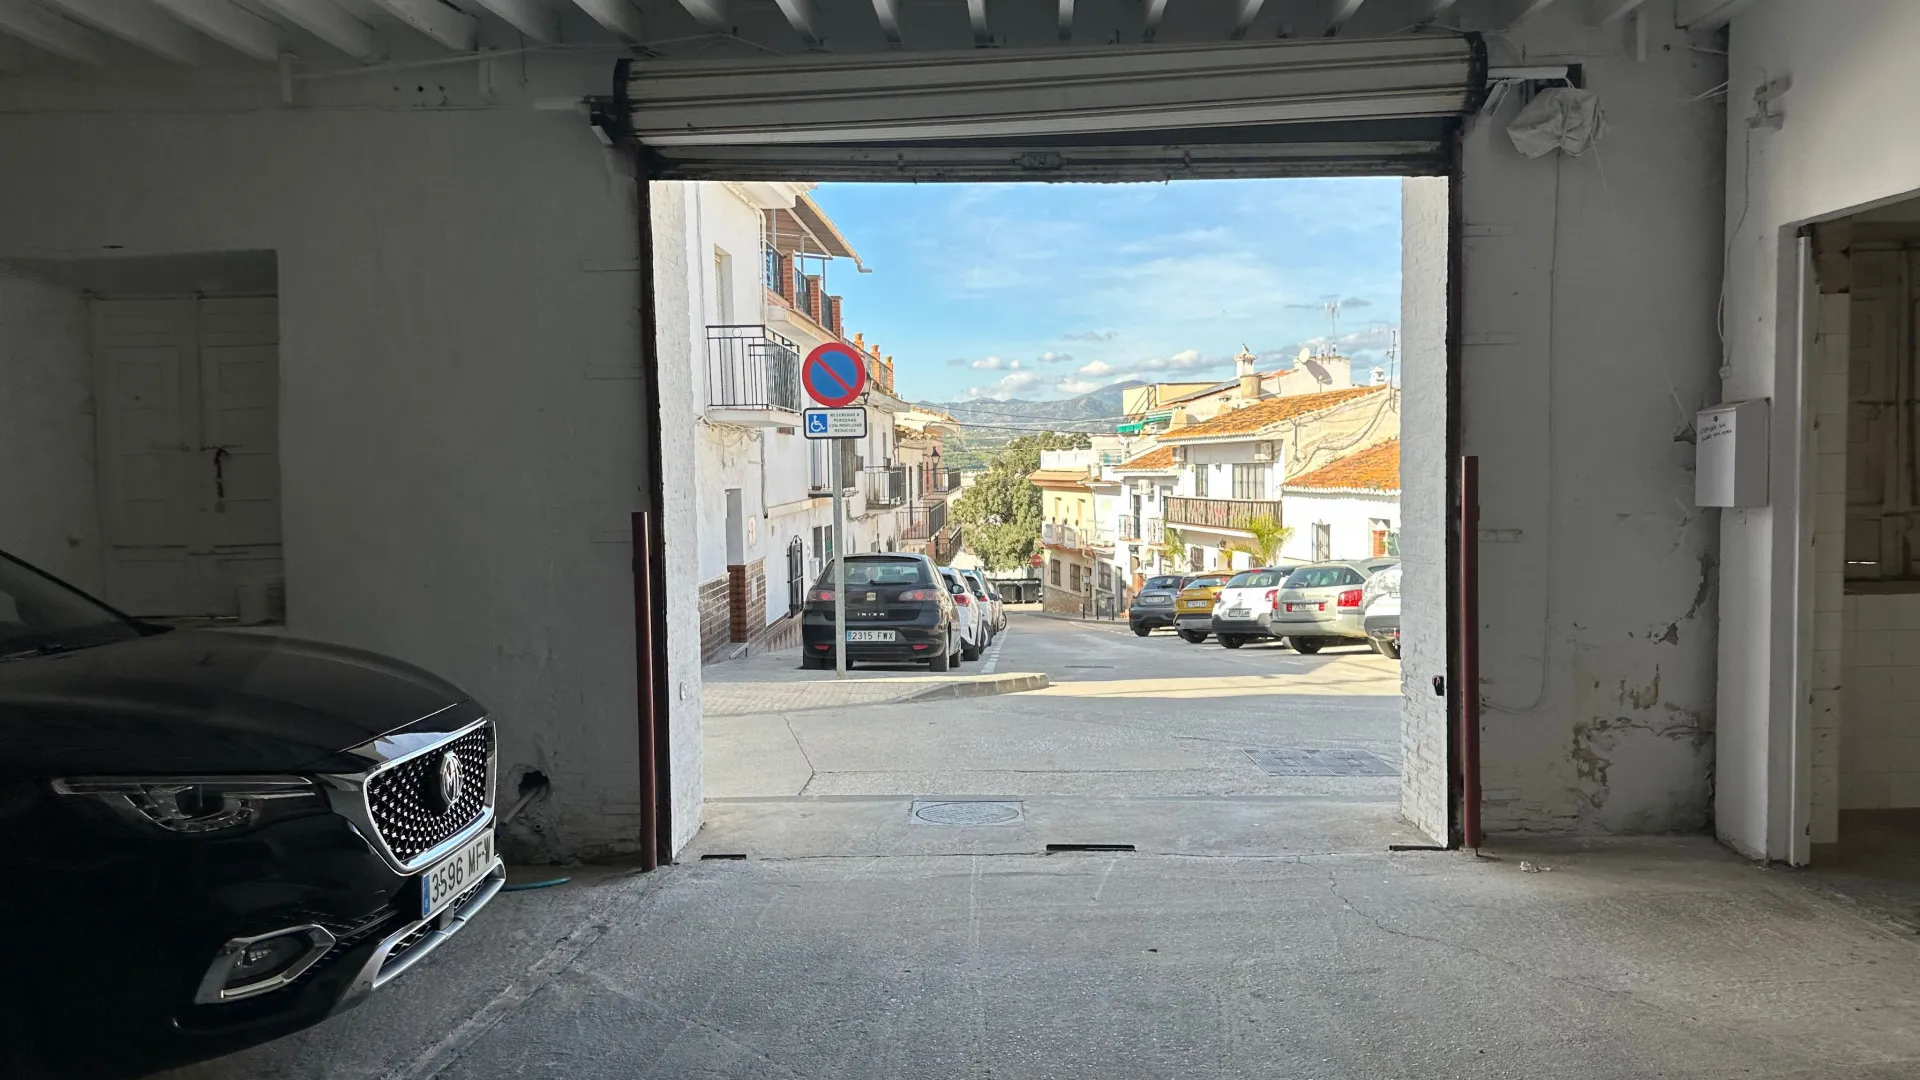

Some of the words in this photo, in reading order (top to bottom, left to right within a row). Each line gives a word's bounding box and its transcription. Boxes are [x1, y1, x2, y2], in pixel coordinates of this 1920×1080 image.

[852, 631, 873, 640] 2315
[877, 631, 894, 640] FWX
[432, 856, 463, 903] 3596
[468, 835, 491, 877] MFW
